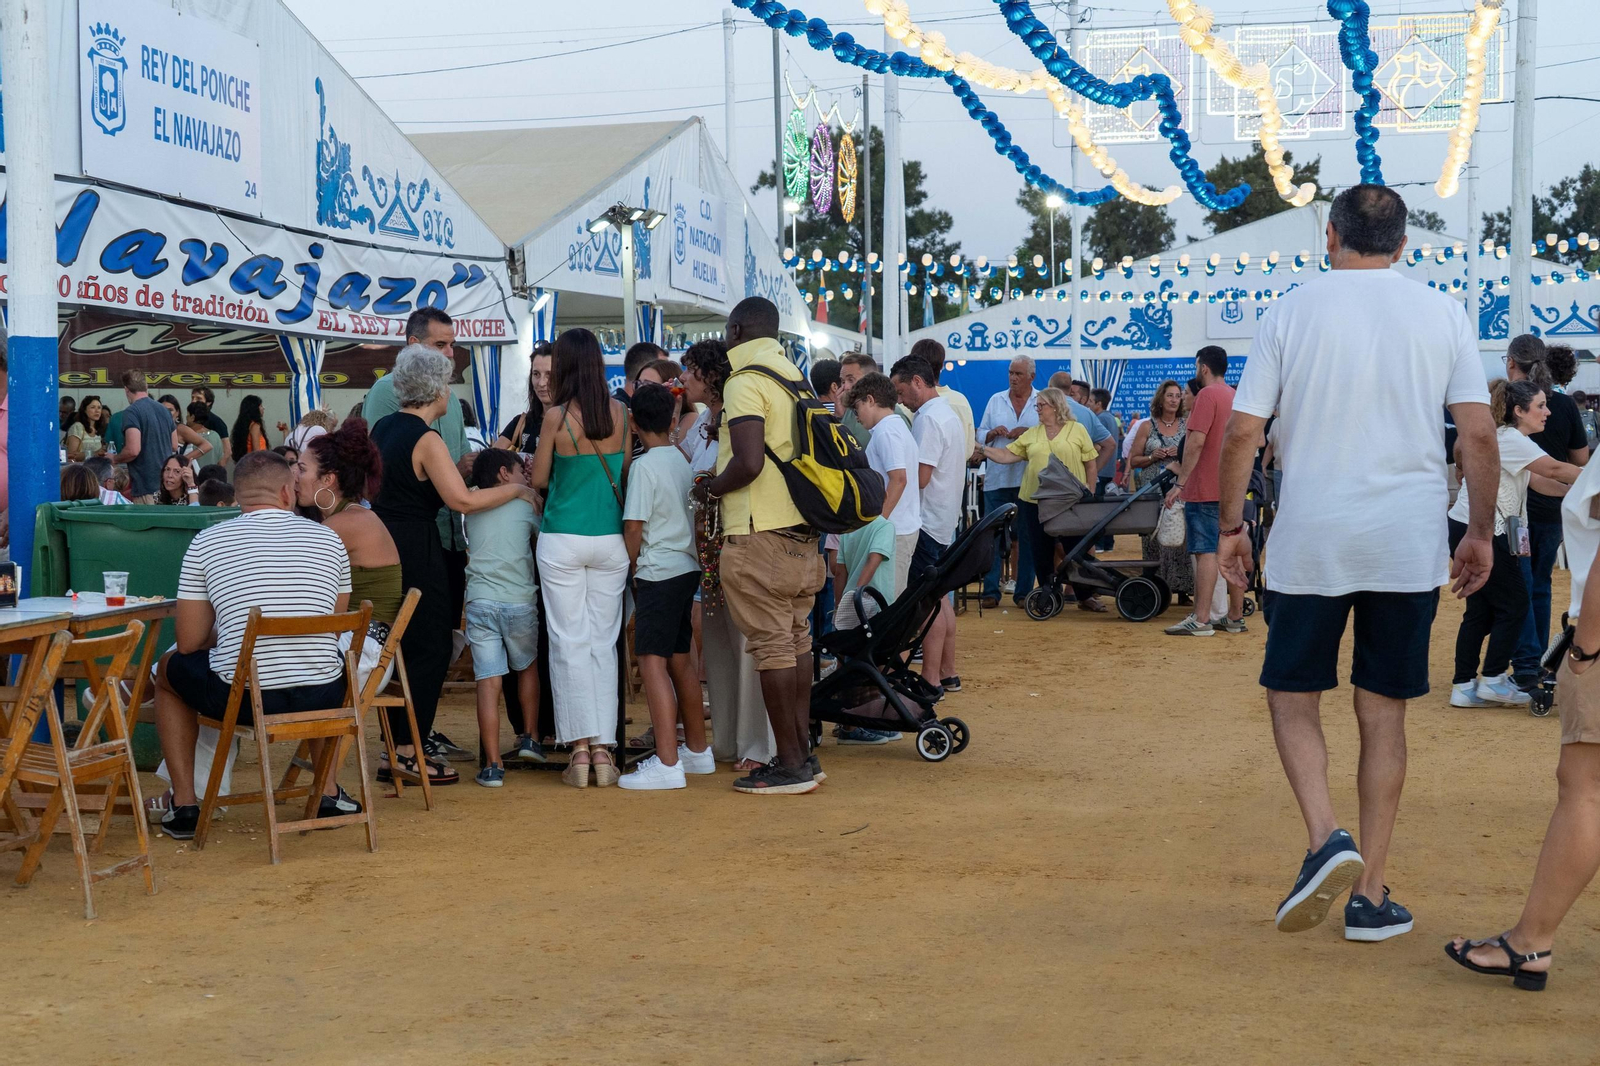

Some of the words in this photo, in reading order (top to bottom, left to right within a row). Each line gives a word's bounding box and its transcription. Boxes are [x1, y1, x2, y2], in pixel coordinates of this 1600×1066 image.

[141, 44, 169, 85] REY
[172, 54, 198, 95] DEL
[200, 64, 251, 113] PONCHE
[154, 106, 170, 143] EL
[173, 112, 242, 163] NAVAJAZO
[244, 180, 257, 199] 24
[689, 226, 722, 257] NATACIÓN
[692, 260, 718, 286] HUELVA
[136, 284, 165, 309] de
[171, 289, 270, 324] tradición
[316, 309, 347, 333] EL
[348, 313, 391, 337] REY
